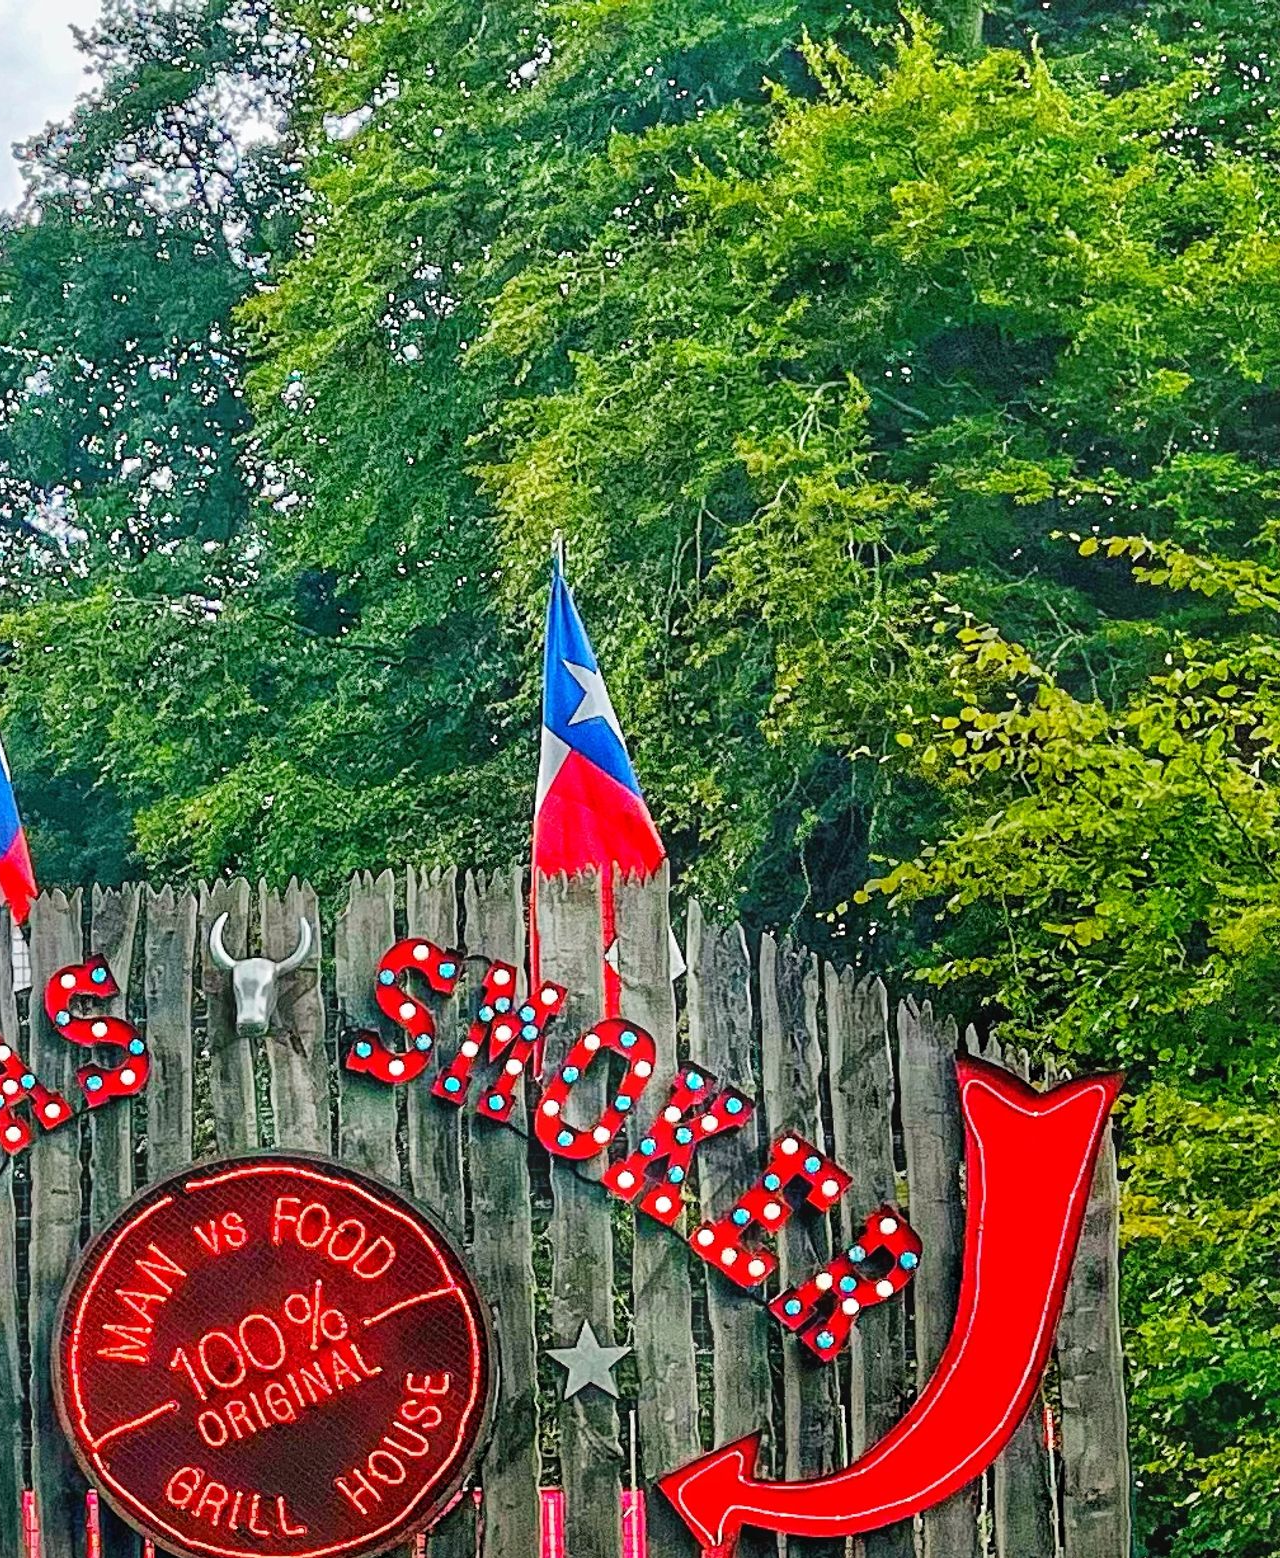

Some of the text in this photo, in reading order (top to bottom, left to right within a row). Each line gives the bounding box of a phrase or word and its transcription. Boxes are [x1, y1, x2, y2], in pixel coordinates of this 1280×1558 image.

[346, 937, 923, 1363] SMOKER
[96, 1244, 188, 1363] MAN
[271, 1197, 396, 1279] FOOD
[169, 1279, 348, 1400] 100%
[166, 1371, 450, 1538] GRILL HOUSE
[197, 1345, 382, 1447] ORIGINAL
